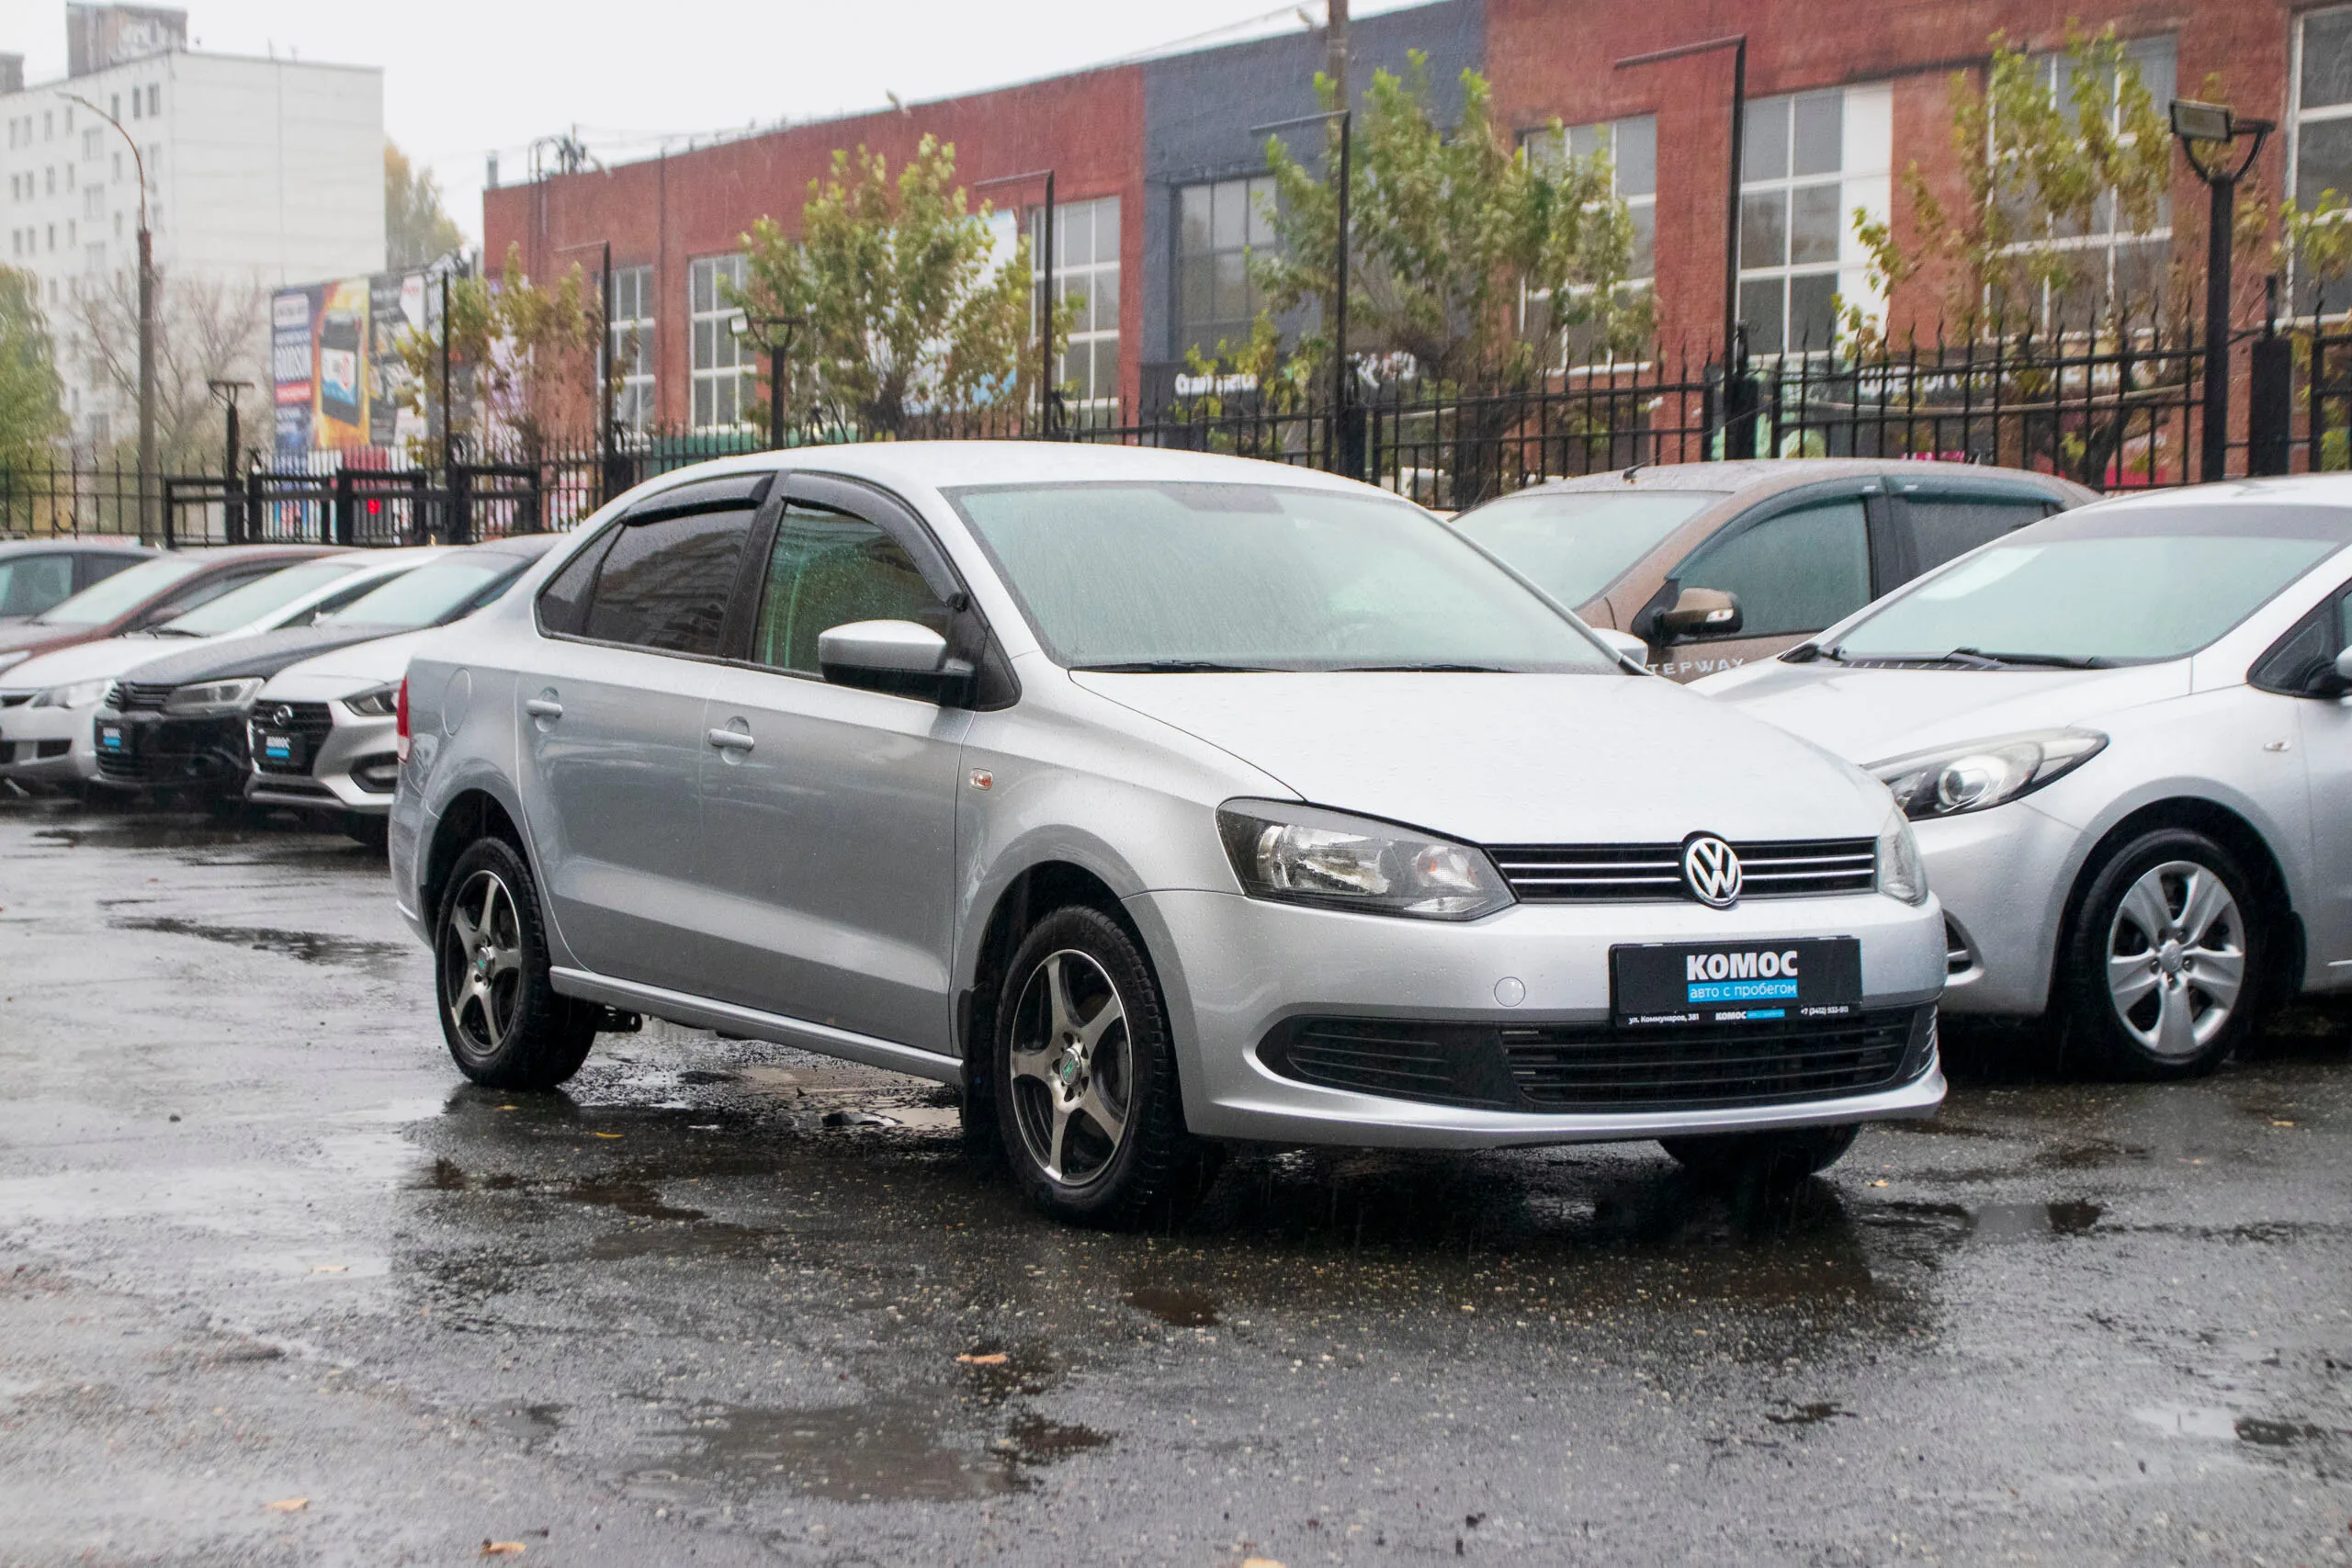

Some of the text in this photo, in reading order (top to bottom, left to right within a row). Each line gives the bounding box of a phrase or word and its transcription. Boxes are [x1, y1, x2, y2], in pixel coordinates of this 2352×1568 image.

[1646, 658, 1744, 675] TEPWAY
[1687, 837, 1742, 903] VW
[1687, 951, 1798, 981] КОМОС
[1690, 982, 1796, 998] авто с пробегом
[1714, 1011, 1747, 1021] КОМОС
